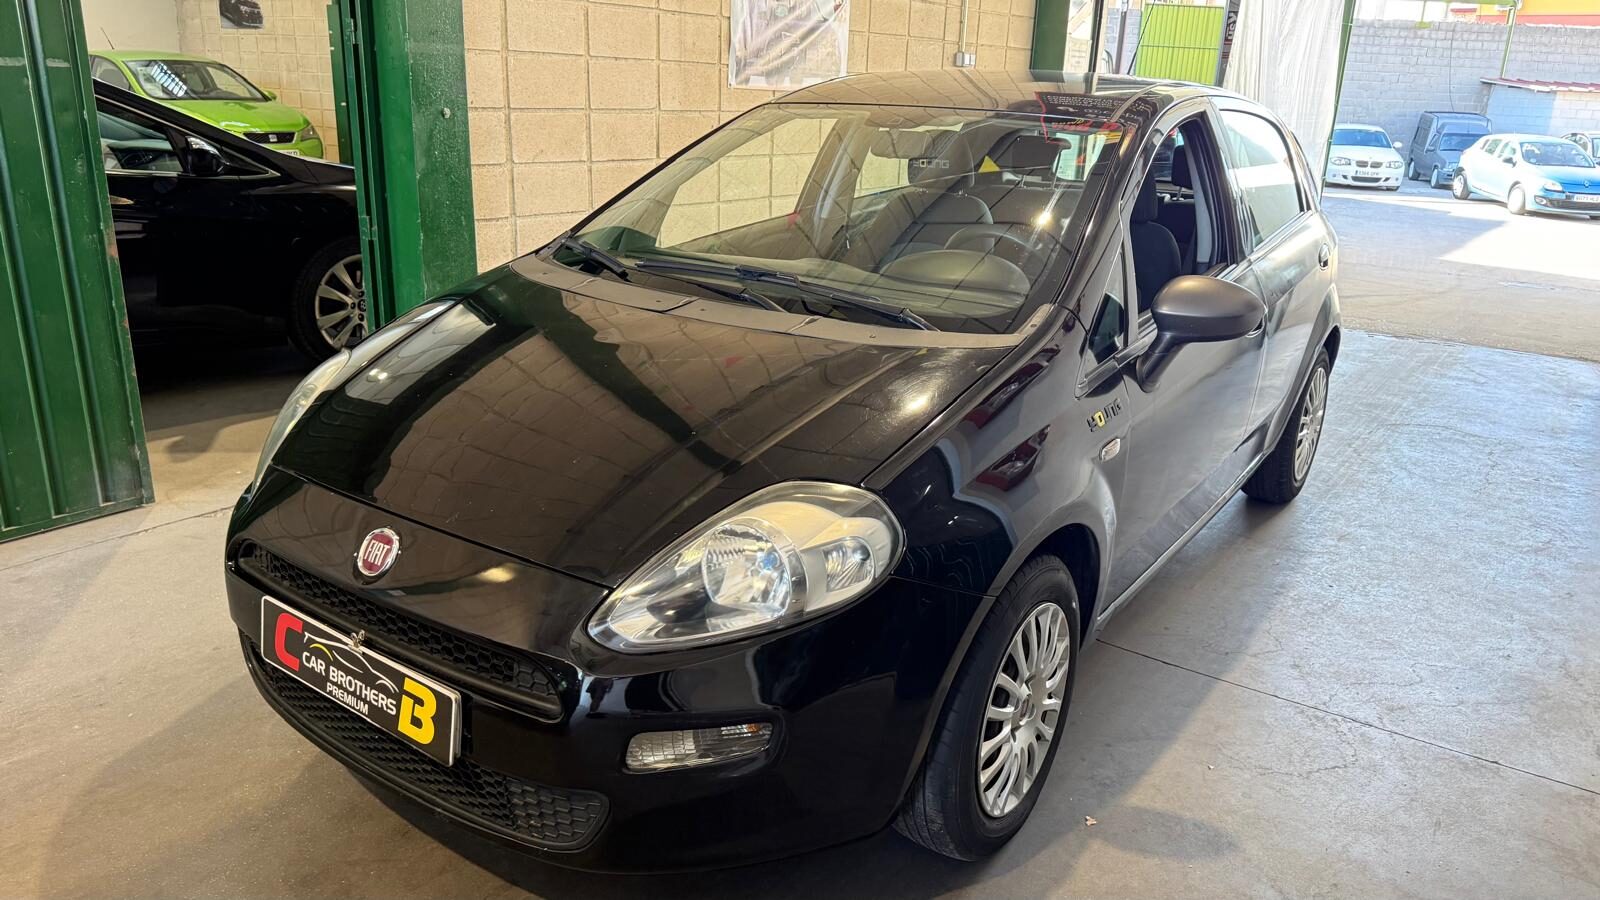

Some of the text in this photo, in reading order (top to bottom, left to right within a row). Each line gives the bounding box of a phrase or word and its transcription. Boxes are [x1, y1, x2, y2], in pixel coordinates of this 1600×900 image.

[364, 539, 391, 566] FIAT
[274, 612, 304, 673] C
[302, 651, 397, 716] CAR BROTHERS
[326, 682, 369, 715] PREMIUM
[397, 677, 437, 745] B
